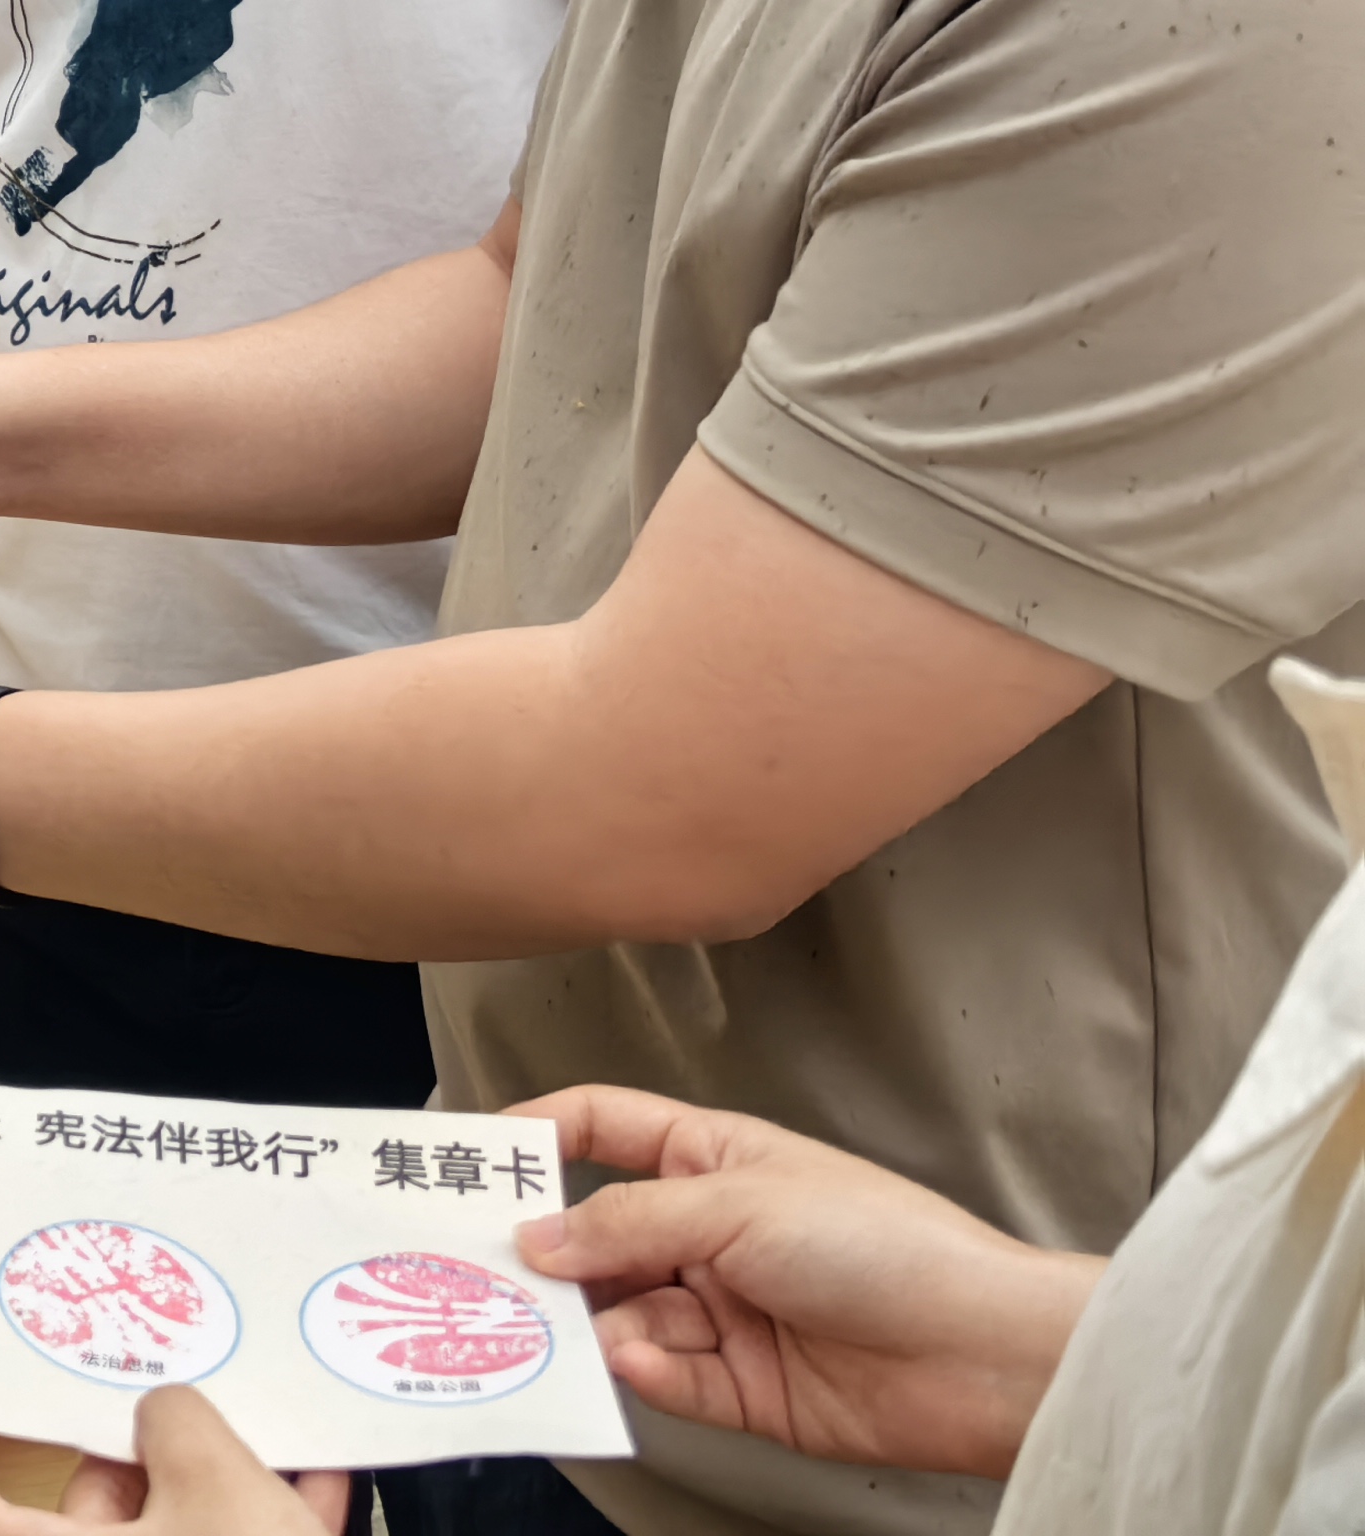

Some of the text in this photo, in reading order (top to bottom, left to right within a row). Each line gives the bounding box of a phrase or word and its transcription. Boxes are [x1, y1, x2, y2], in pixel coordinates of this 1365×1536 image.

[35, 1110, 339, 1178] 宪法伴我行”
[372, 1139, 547, 1200] 集章卡
